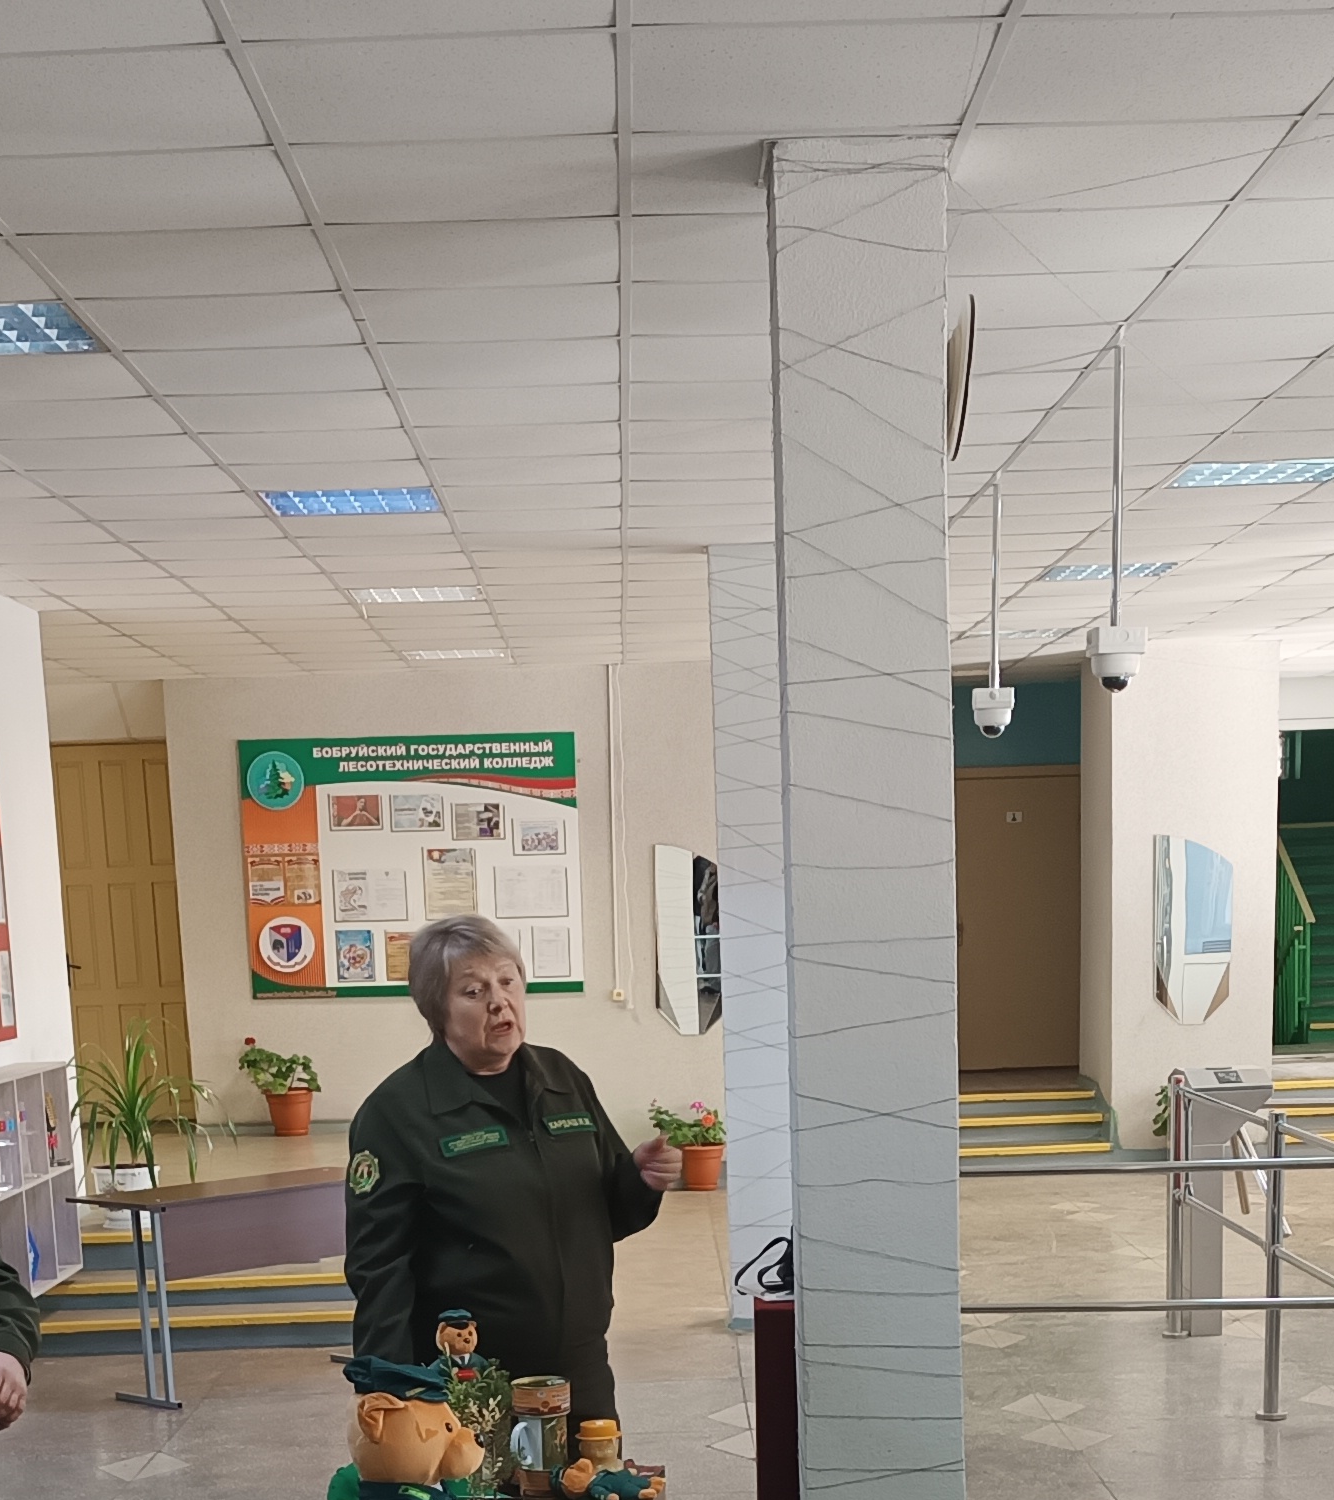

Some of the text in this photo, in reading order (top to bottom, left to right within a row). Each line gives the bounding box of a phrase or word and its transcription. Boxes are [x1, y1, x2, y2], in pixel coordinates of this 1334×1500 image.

[313, 739, 553, 758] БОБРУЙСКИЙ ГОСУДАРСТВЕННЫЙ
[338, 755, 554, 772] ЛЕСОТЕХНИЧЕСКИЙ КОЛЛЕДЖ
